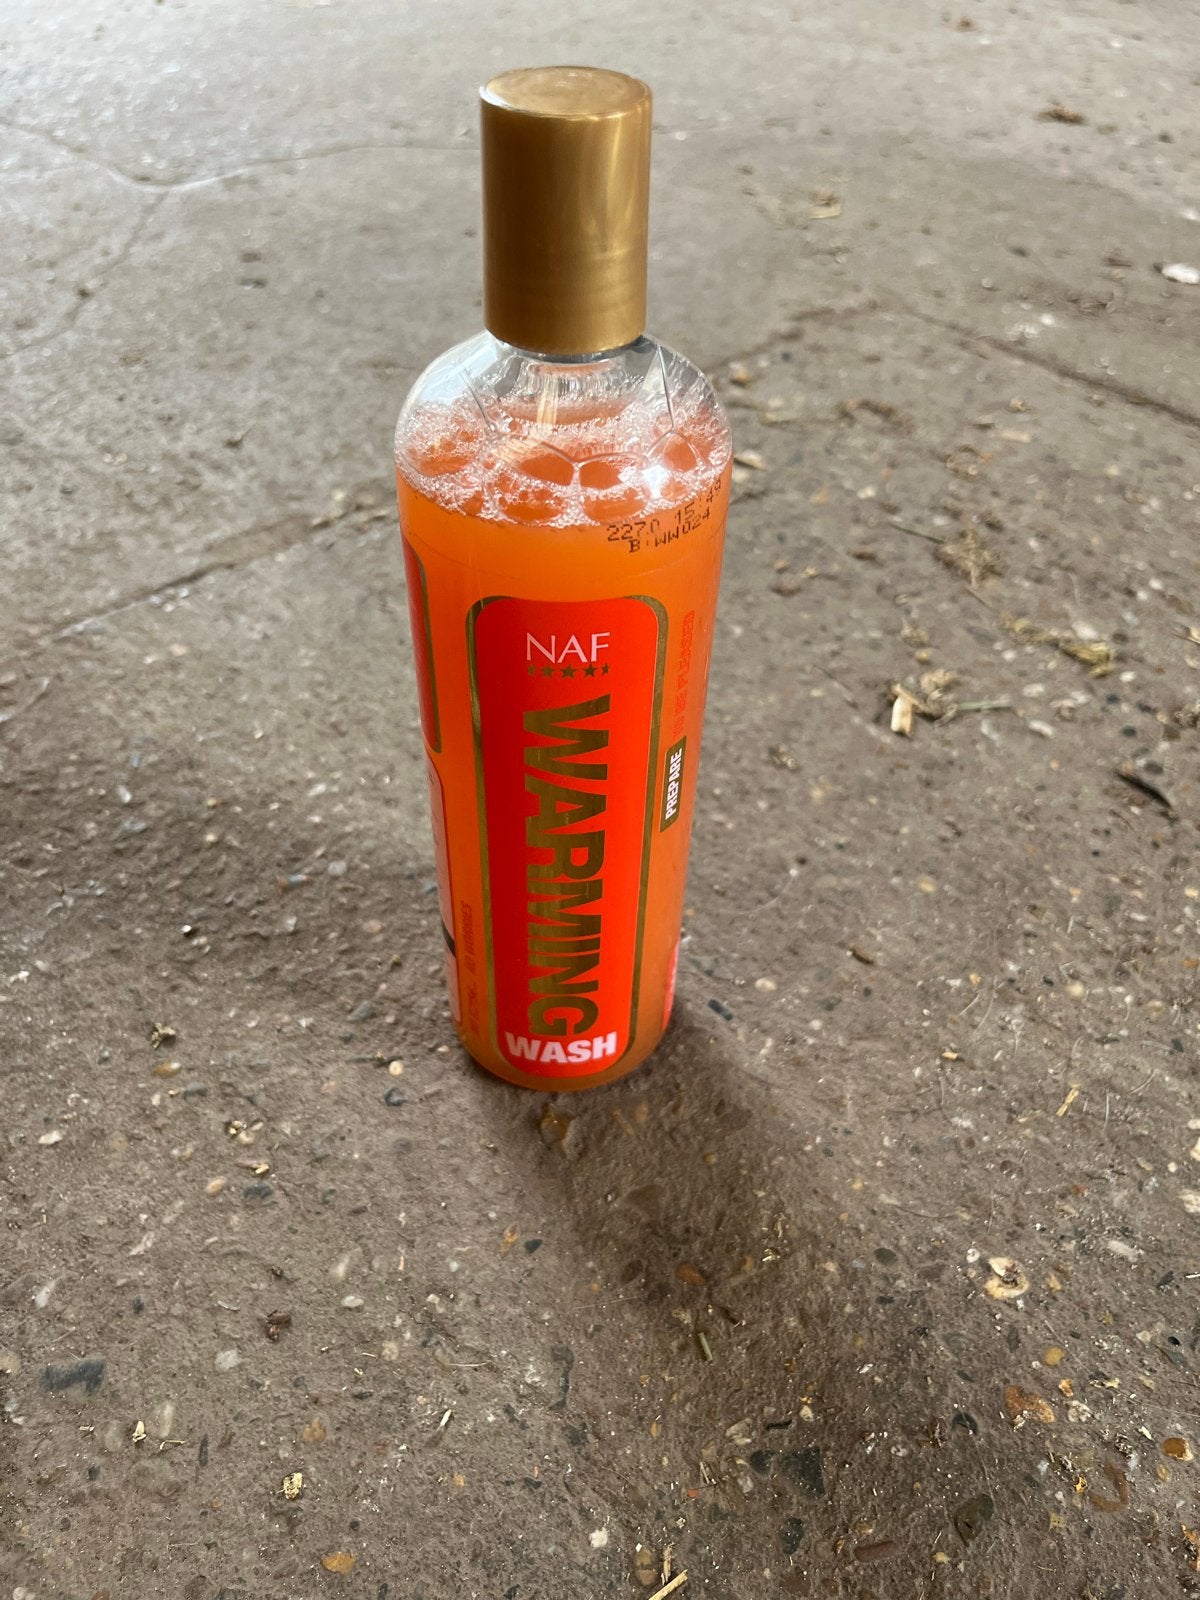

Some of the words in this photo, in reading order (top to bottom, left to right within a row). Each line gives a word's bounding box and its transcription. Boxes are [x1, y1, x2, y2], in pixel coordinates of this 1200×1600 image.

[526, 632, 610, 664] NAF
[665, 748, 683, 820] PREPARE
[523, 694, 611, 1036] WARMING
[504, 1031, 617, 1064] WASH
